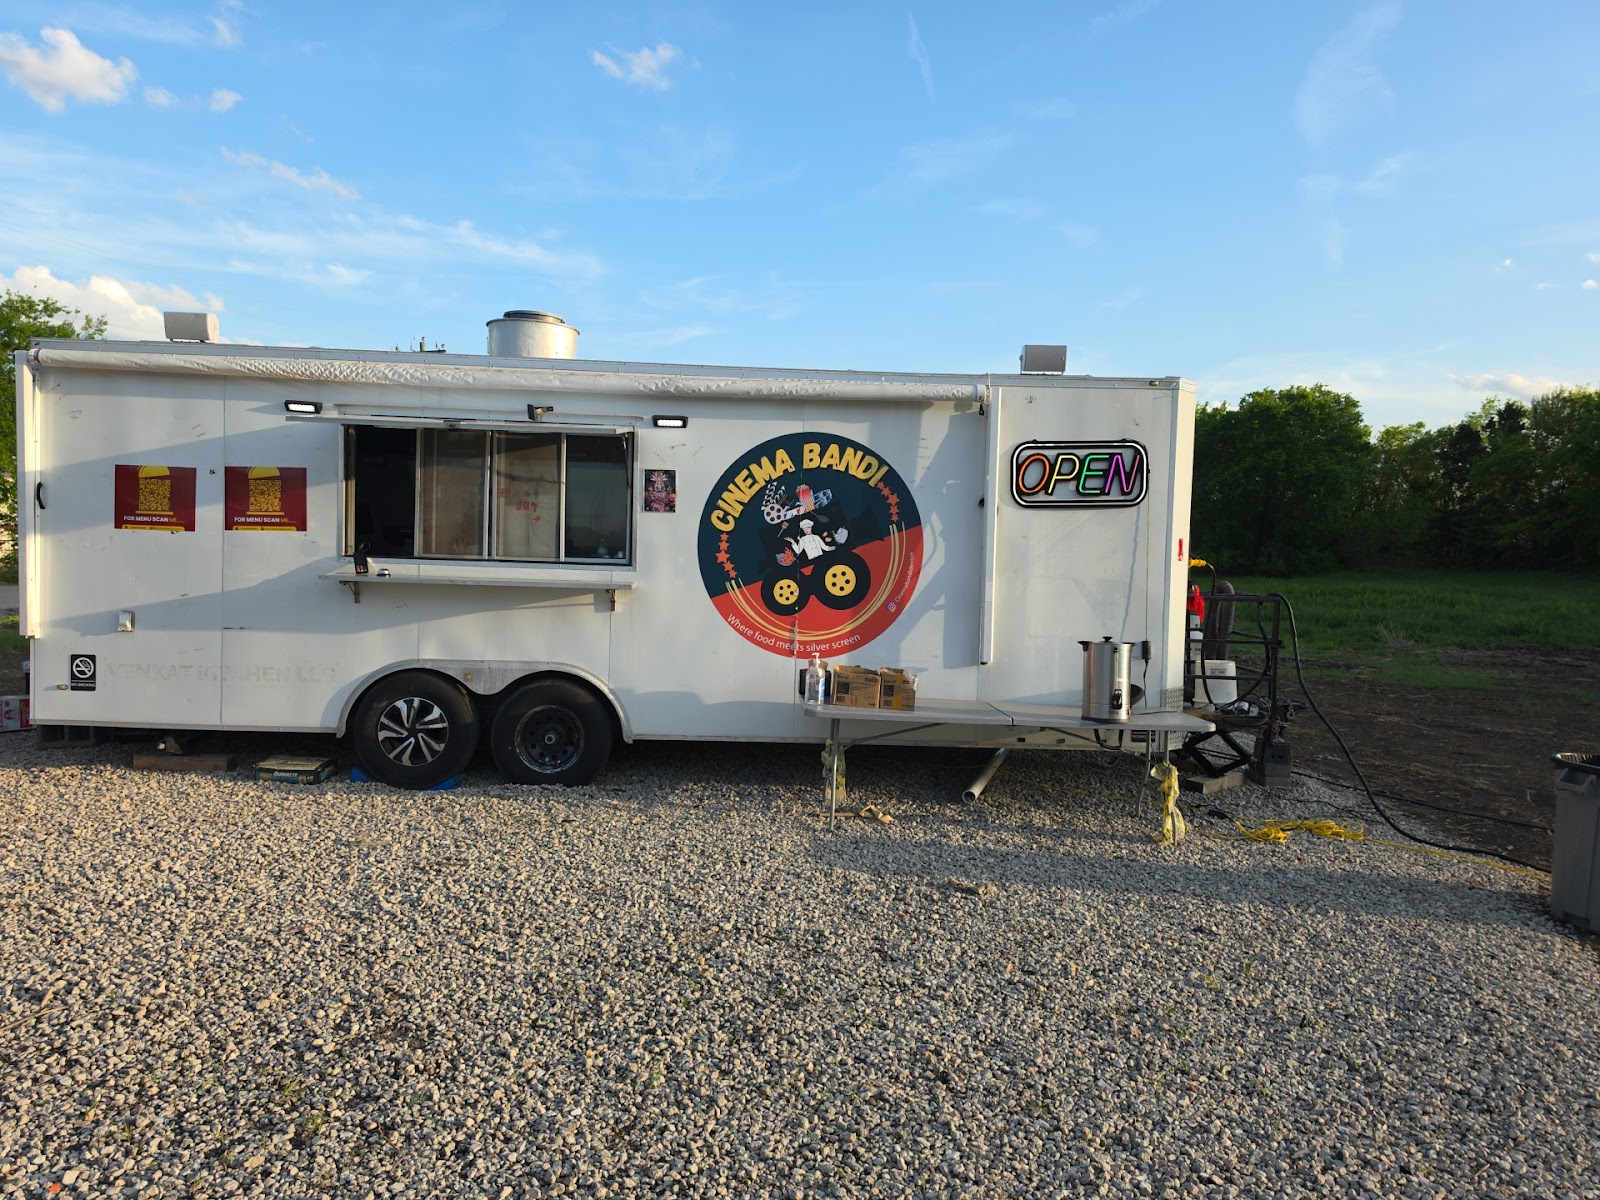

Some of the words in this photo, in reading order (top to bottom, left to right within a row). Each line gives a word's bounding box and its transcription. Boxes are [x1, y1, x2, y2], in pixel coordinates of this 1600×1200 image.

[711, 448, 796, 532] CINEMA
[802, 442, 890, 487] BANDI
[1018, 454, 1140, 494] OPEN
[727, 614, 754, 637] Where
[753, 630, 776, 646] food
[775, 640, 804, 652] meets
[806, 642, 829, 652] silver
[831, 634, 861, 649] screen
